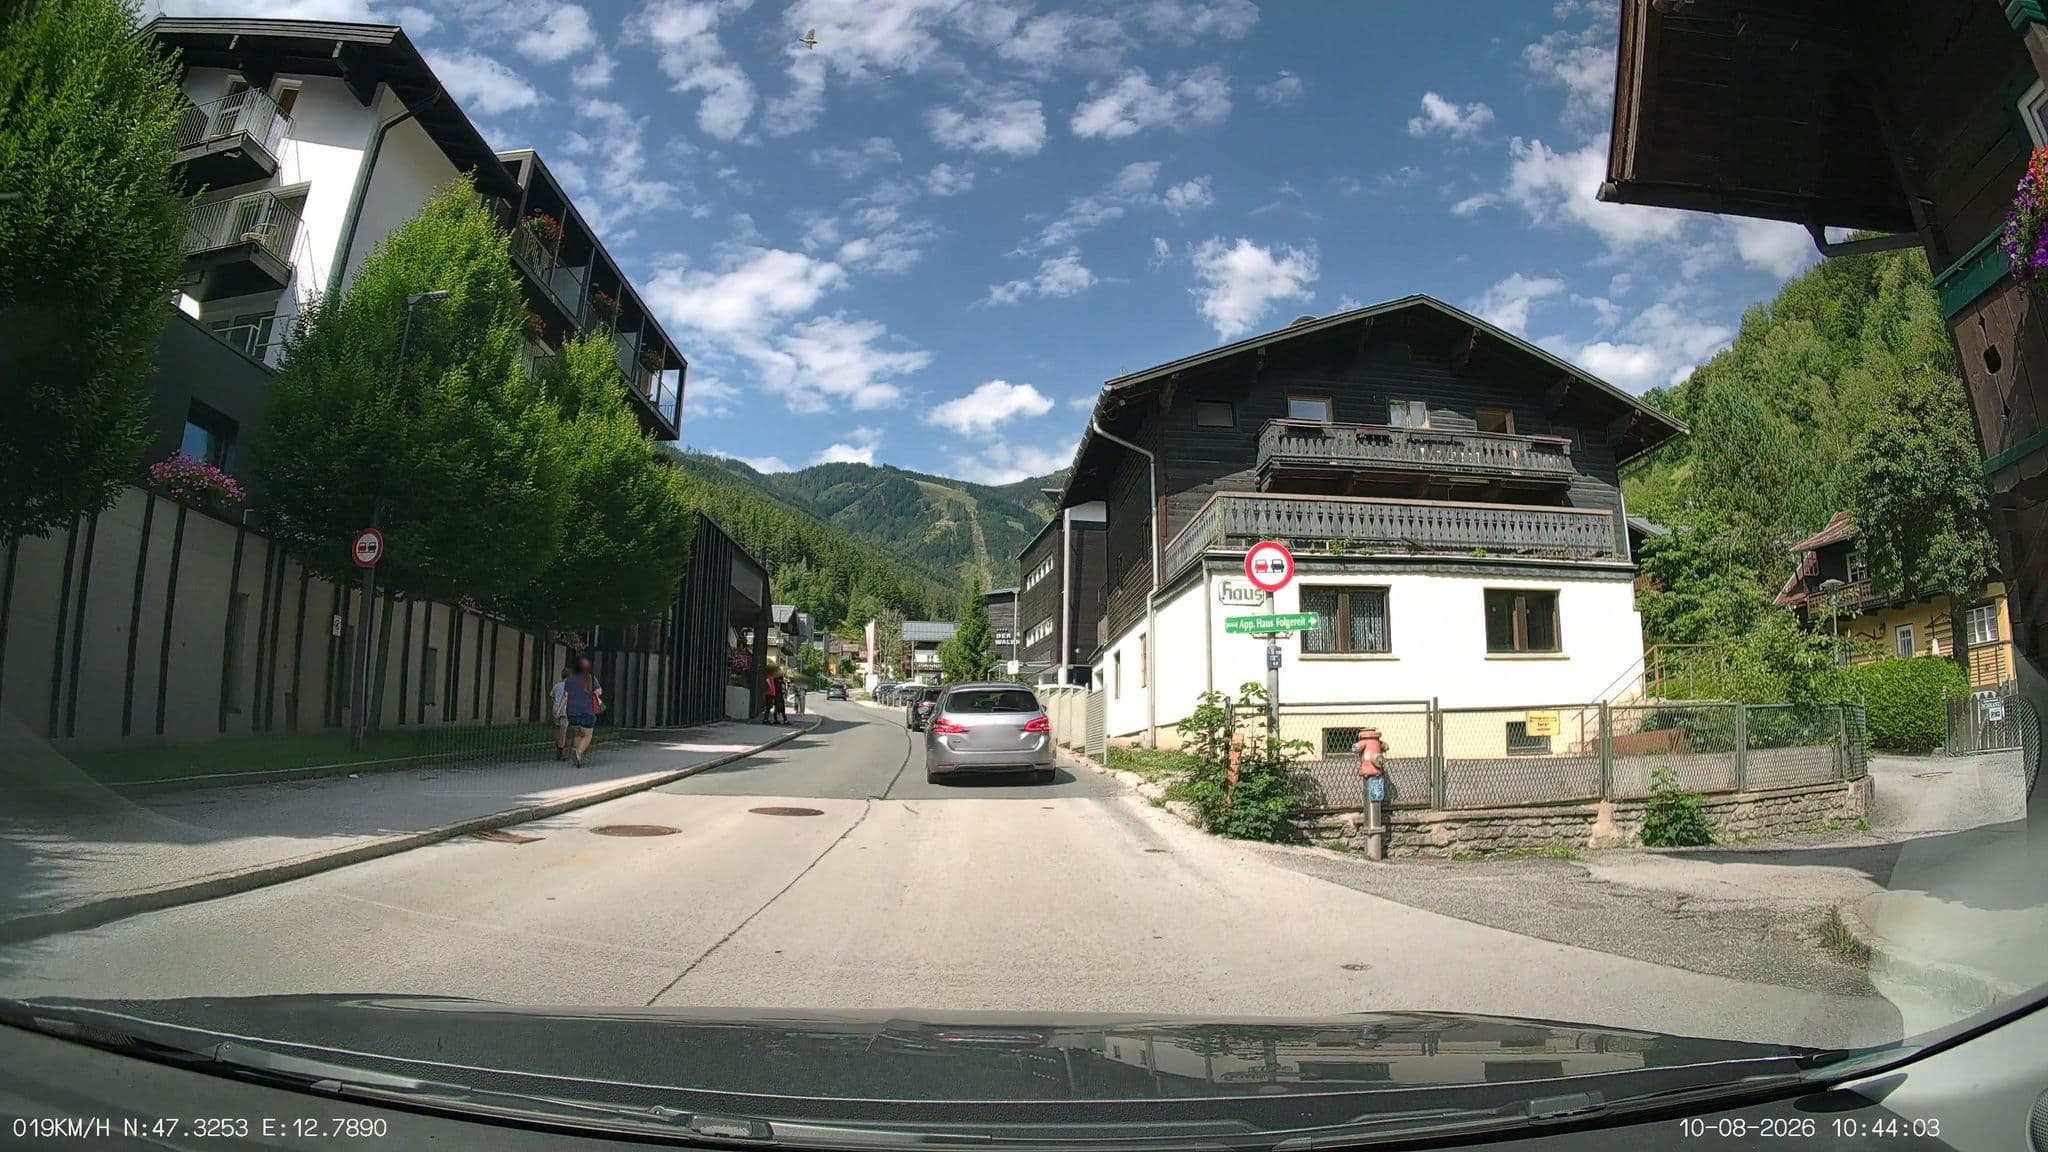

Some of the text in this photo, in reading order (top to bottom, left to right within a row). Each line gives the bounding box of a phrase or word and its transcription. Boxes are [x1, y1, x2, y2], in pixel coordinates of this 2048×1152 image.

[1238, 615, 1306, 631] App. Haus Folgereit
